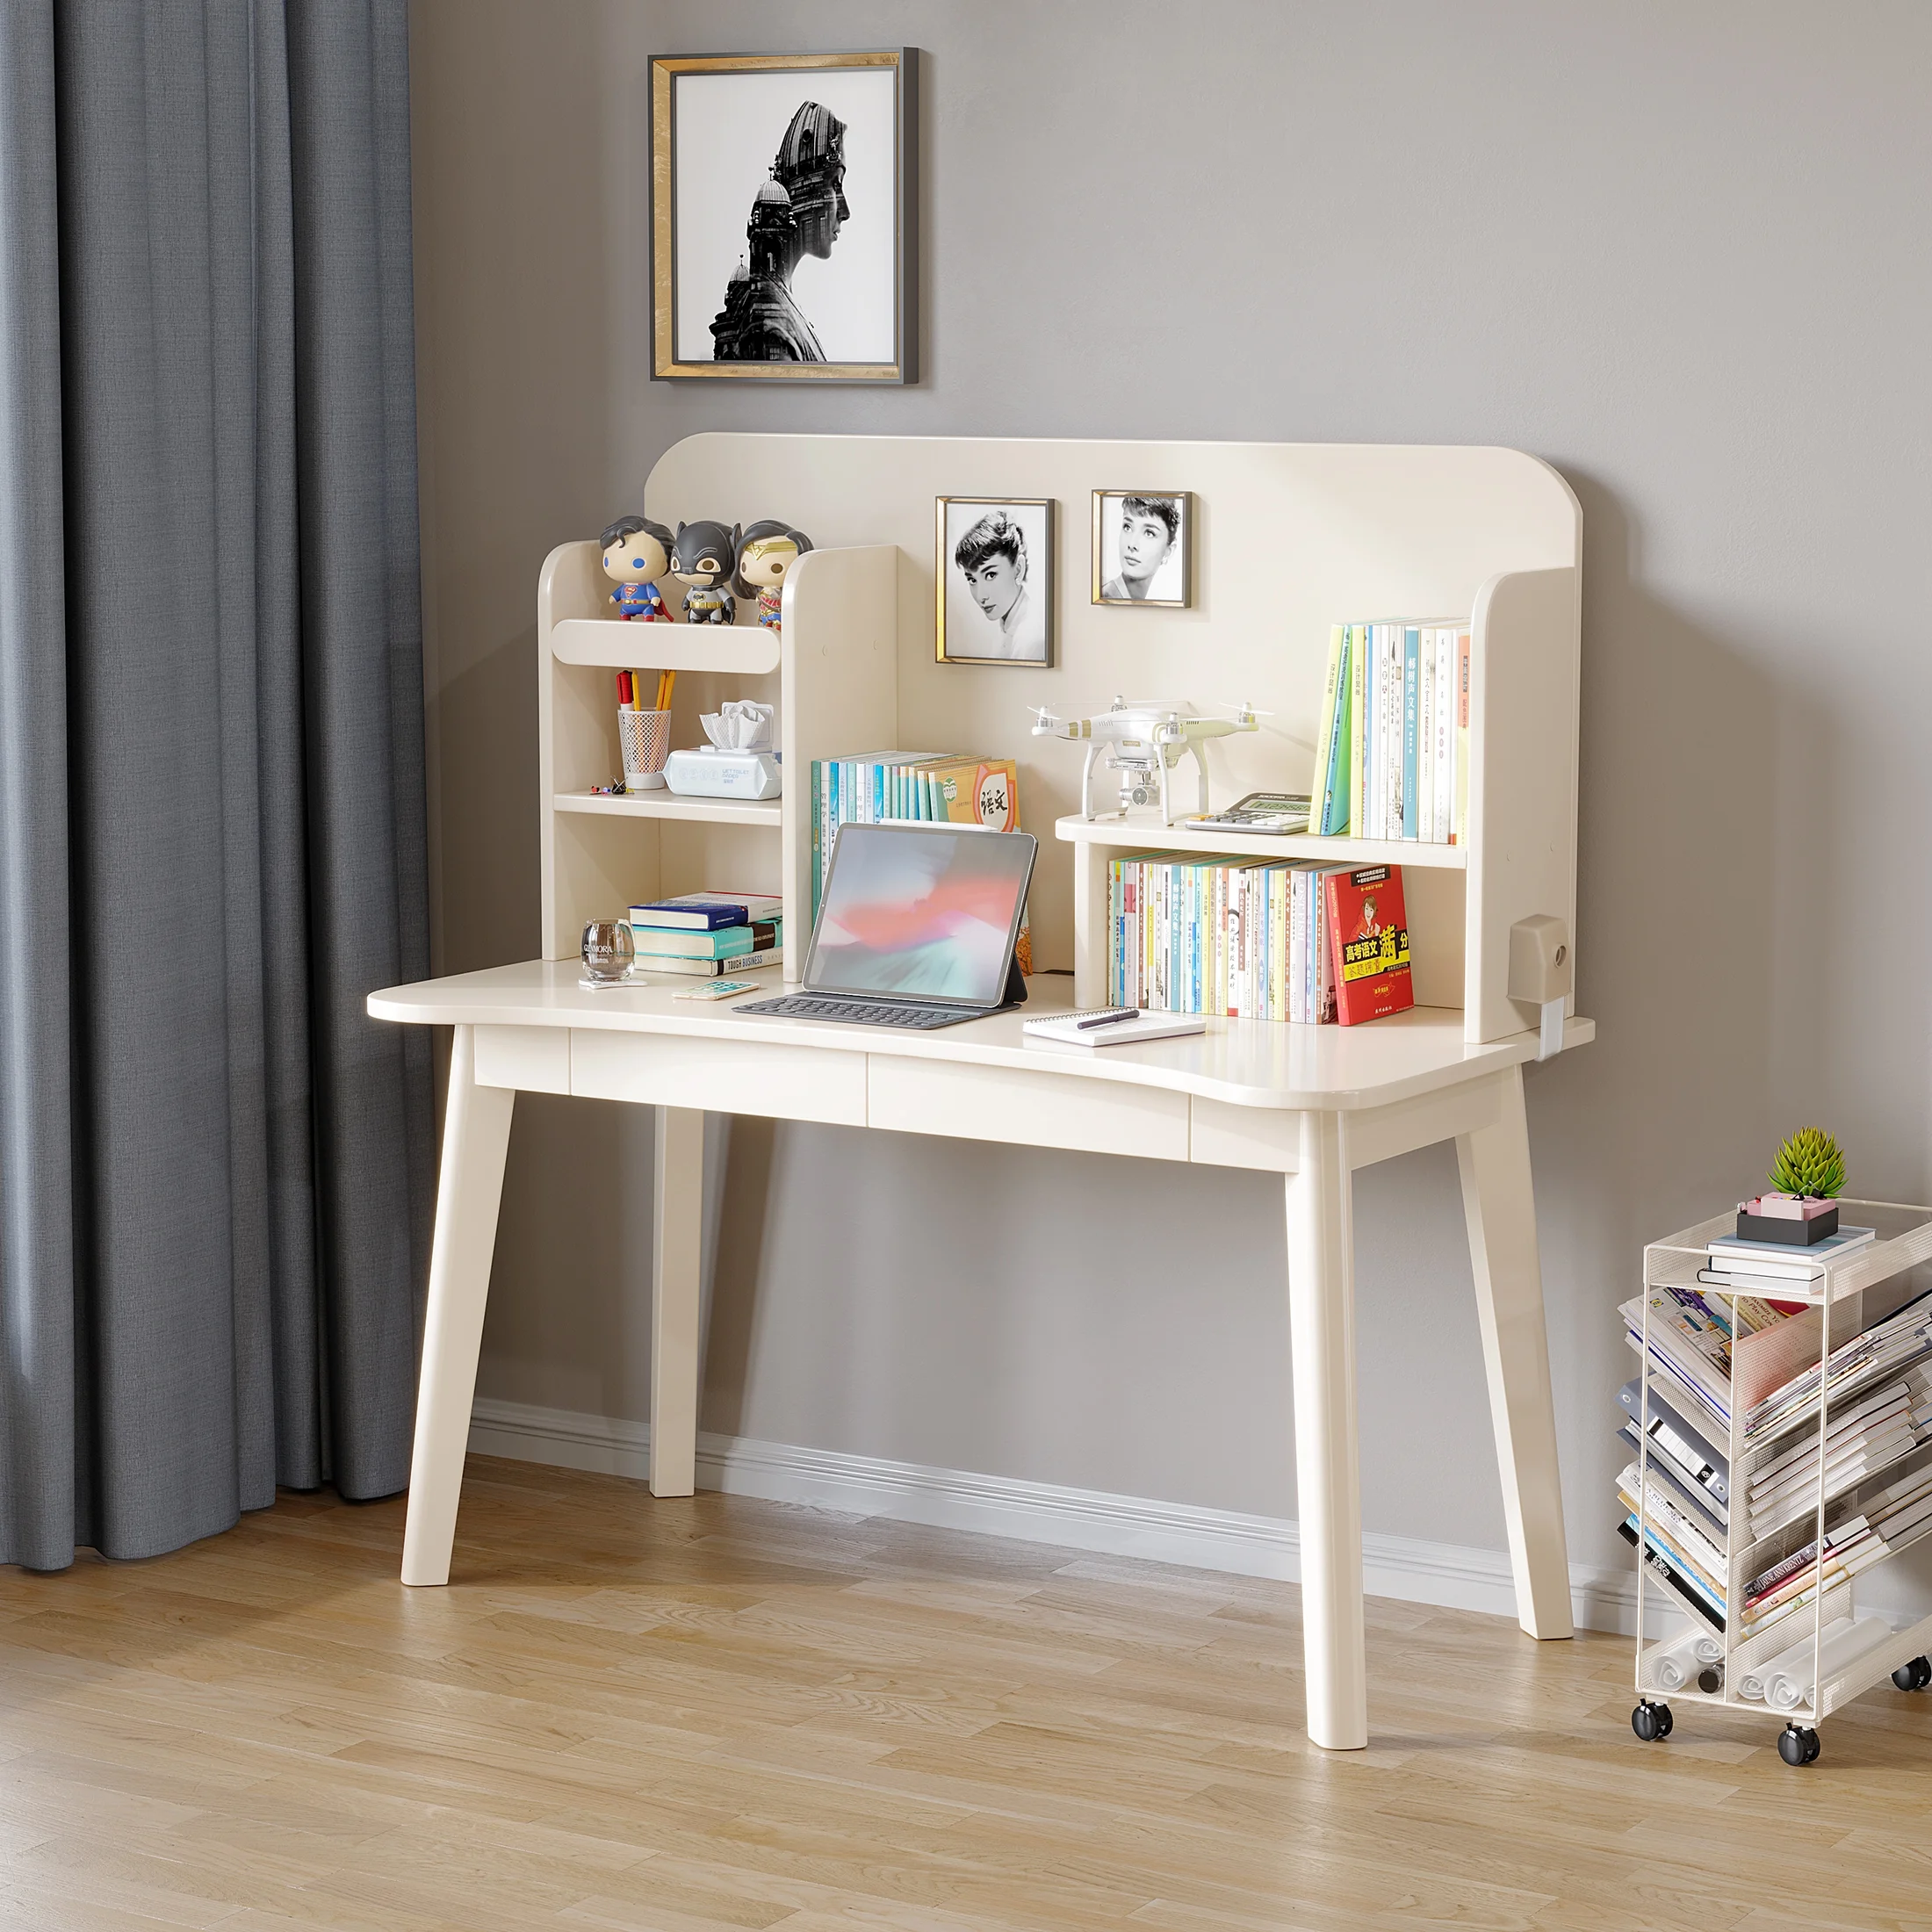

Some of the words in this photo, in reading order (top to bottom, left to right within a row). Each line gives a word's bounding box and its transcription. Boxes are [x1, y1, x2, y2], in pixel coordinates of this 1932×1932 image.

[981, 789, 1008, 816] 语文
[728, 959, 742, 970] TOUGH
[742, 955, 762, 967] BUSINESS
